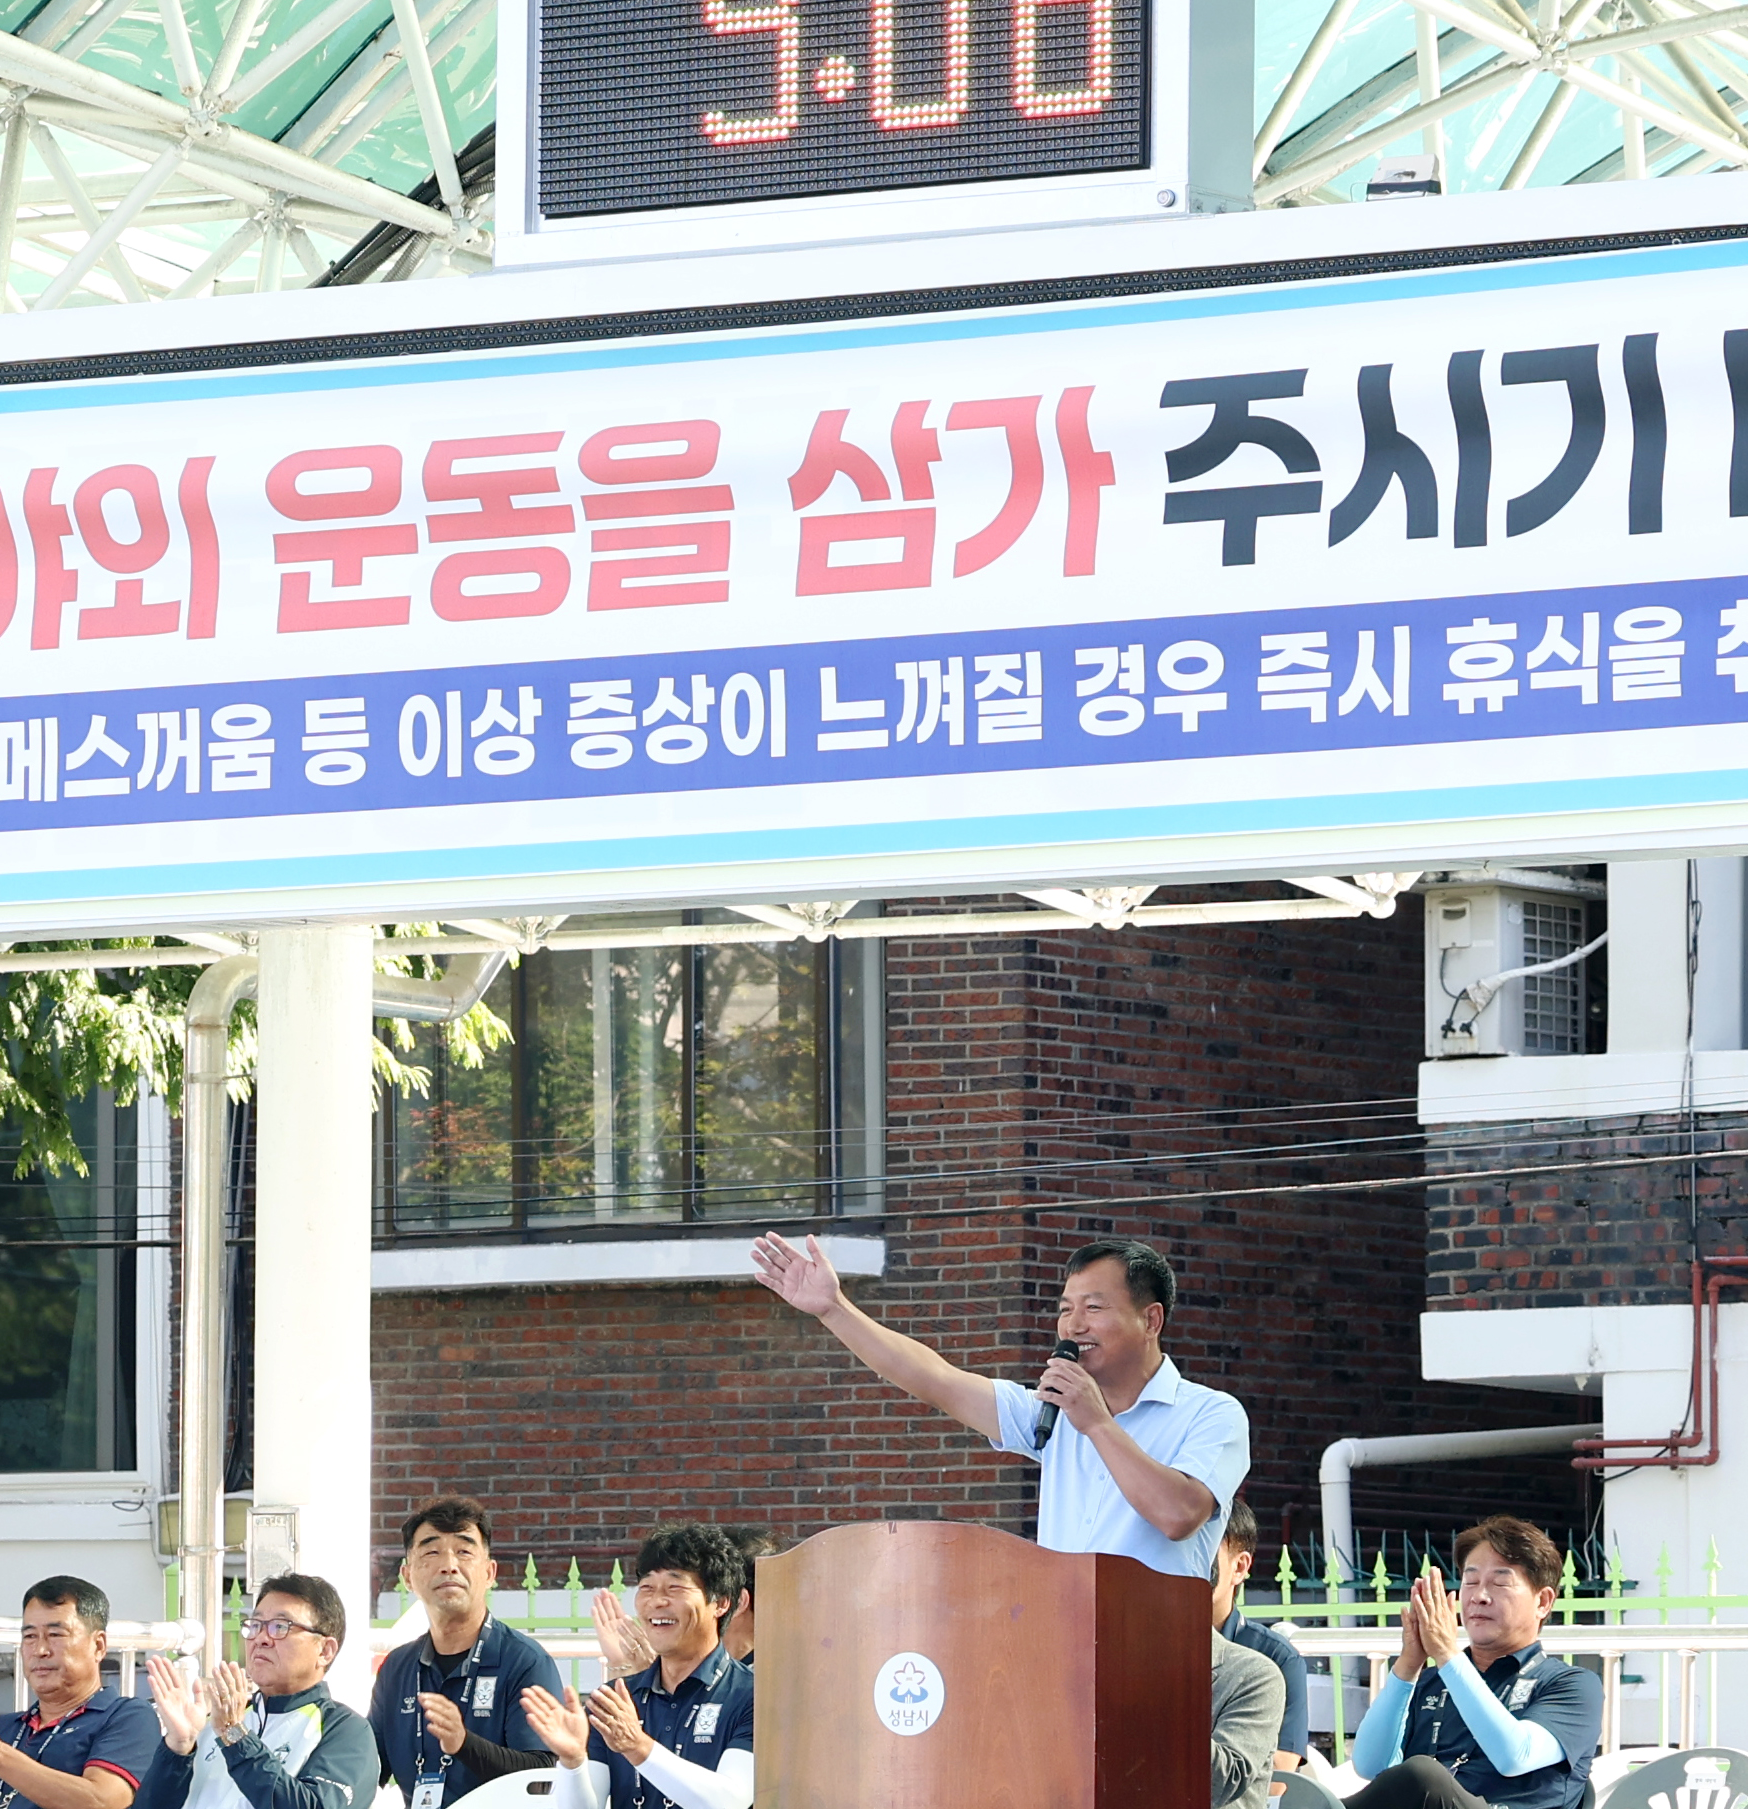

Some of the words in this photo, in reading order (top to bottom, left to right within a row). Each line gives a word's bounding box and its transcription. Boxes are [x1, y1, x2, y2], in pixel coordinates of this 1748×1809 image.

[264, 418, 736, 634] 운동을
[786, 384, 1117, 597] 삼가
[1158, 331, 1668, 567] 주시기
[300, 696, 371, 786] 등
[397, 684, 543, 778] 이상
[565, 667, 787, 767] 증상이
[816, 650, 1045, 753] 느껴질
[1074, 639, 1229, 737] 경우
[1256, 625, 1412, 724] 즉시
[1442, 605, 1686, 715] 휴식을
[888, 1709, 929, 1727] 성남시
